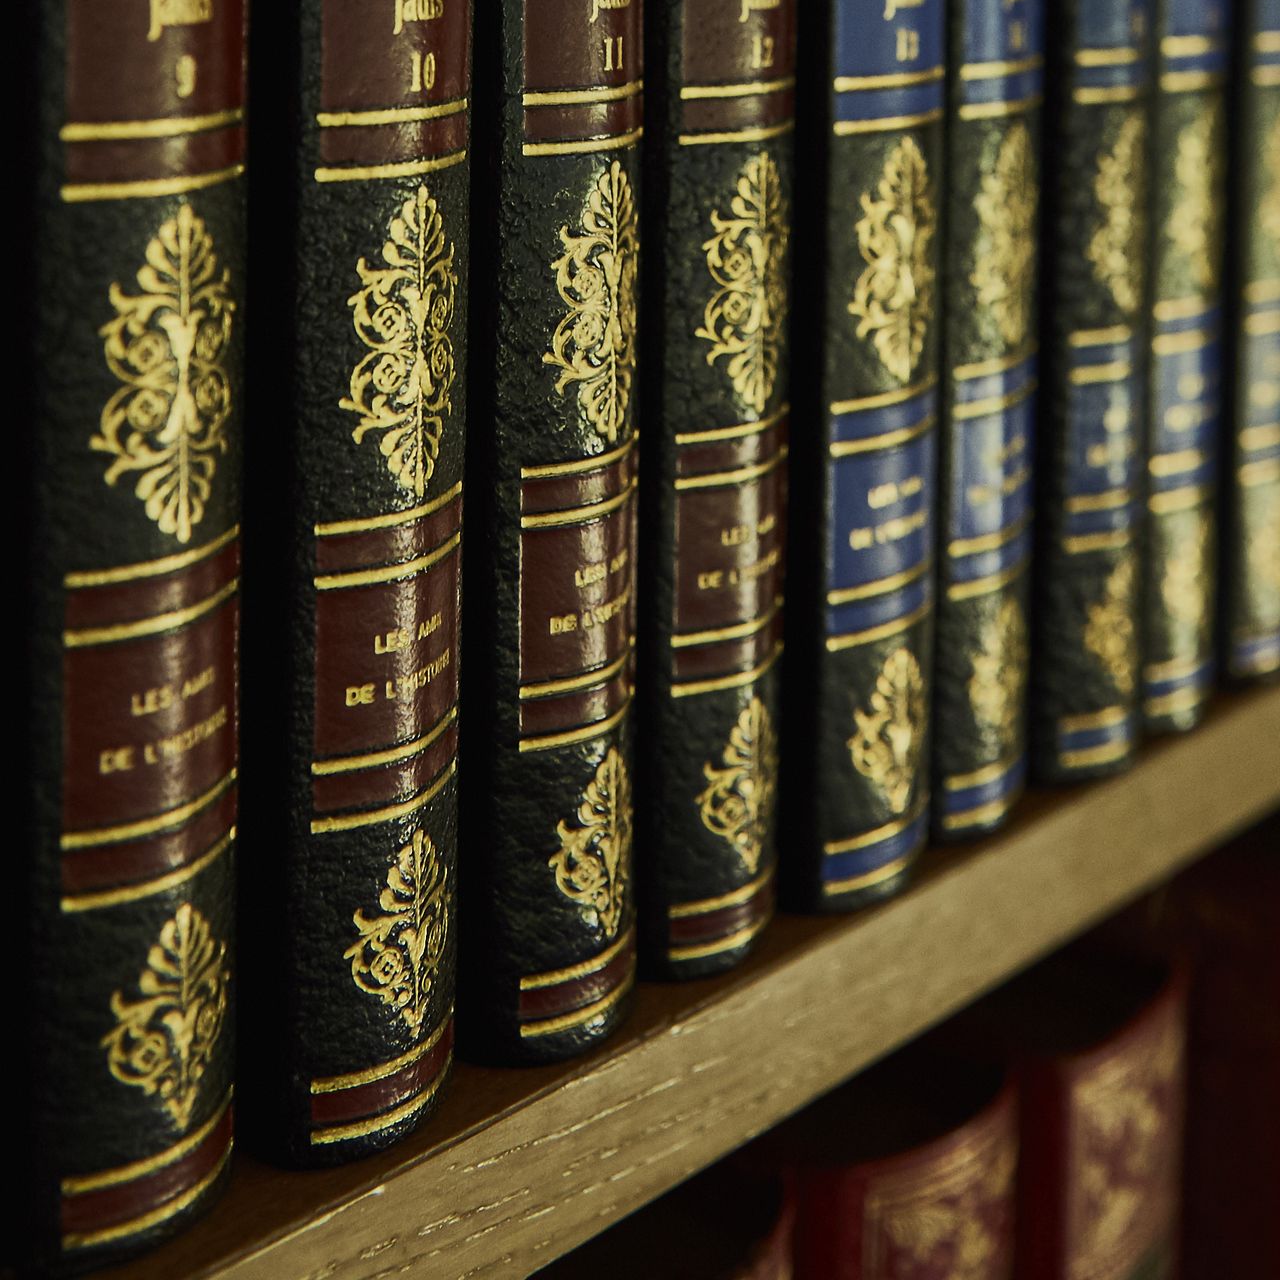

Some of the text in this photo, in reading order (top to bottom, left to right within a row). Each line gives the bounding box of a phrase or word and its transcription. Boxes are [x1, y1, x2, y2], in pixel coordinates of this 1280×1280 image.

[604, 36, 623, 70] 11
[751, 37, 774, 68] 12
[175, 55, 197, 98] 9
[411, 52, 436, 91] 10
[375, 627, 410, 654] LES
[346, 683, 375, 706] DE
